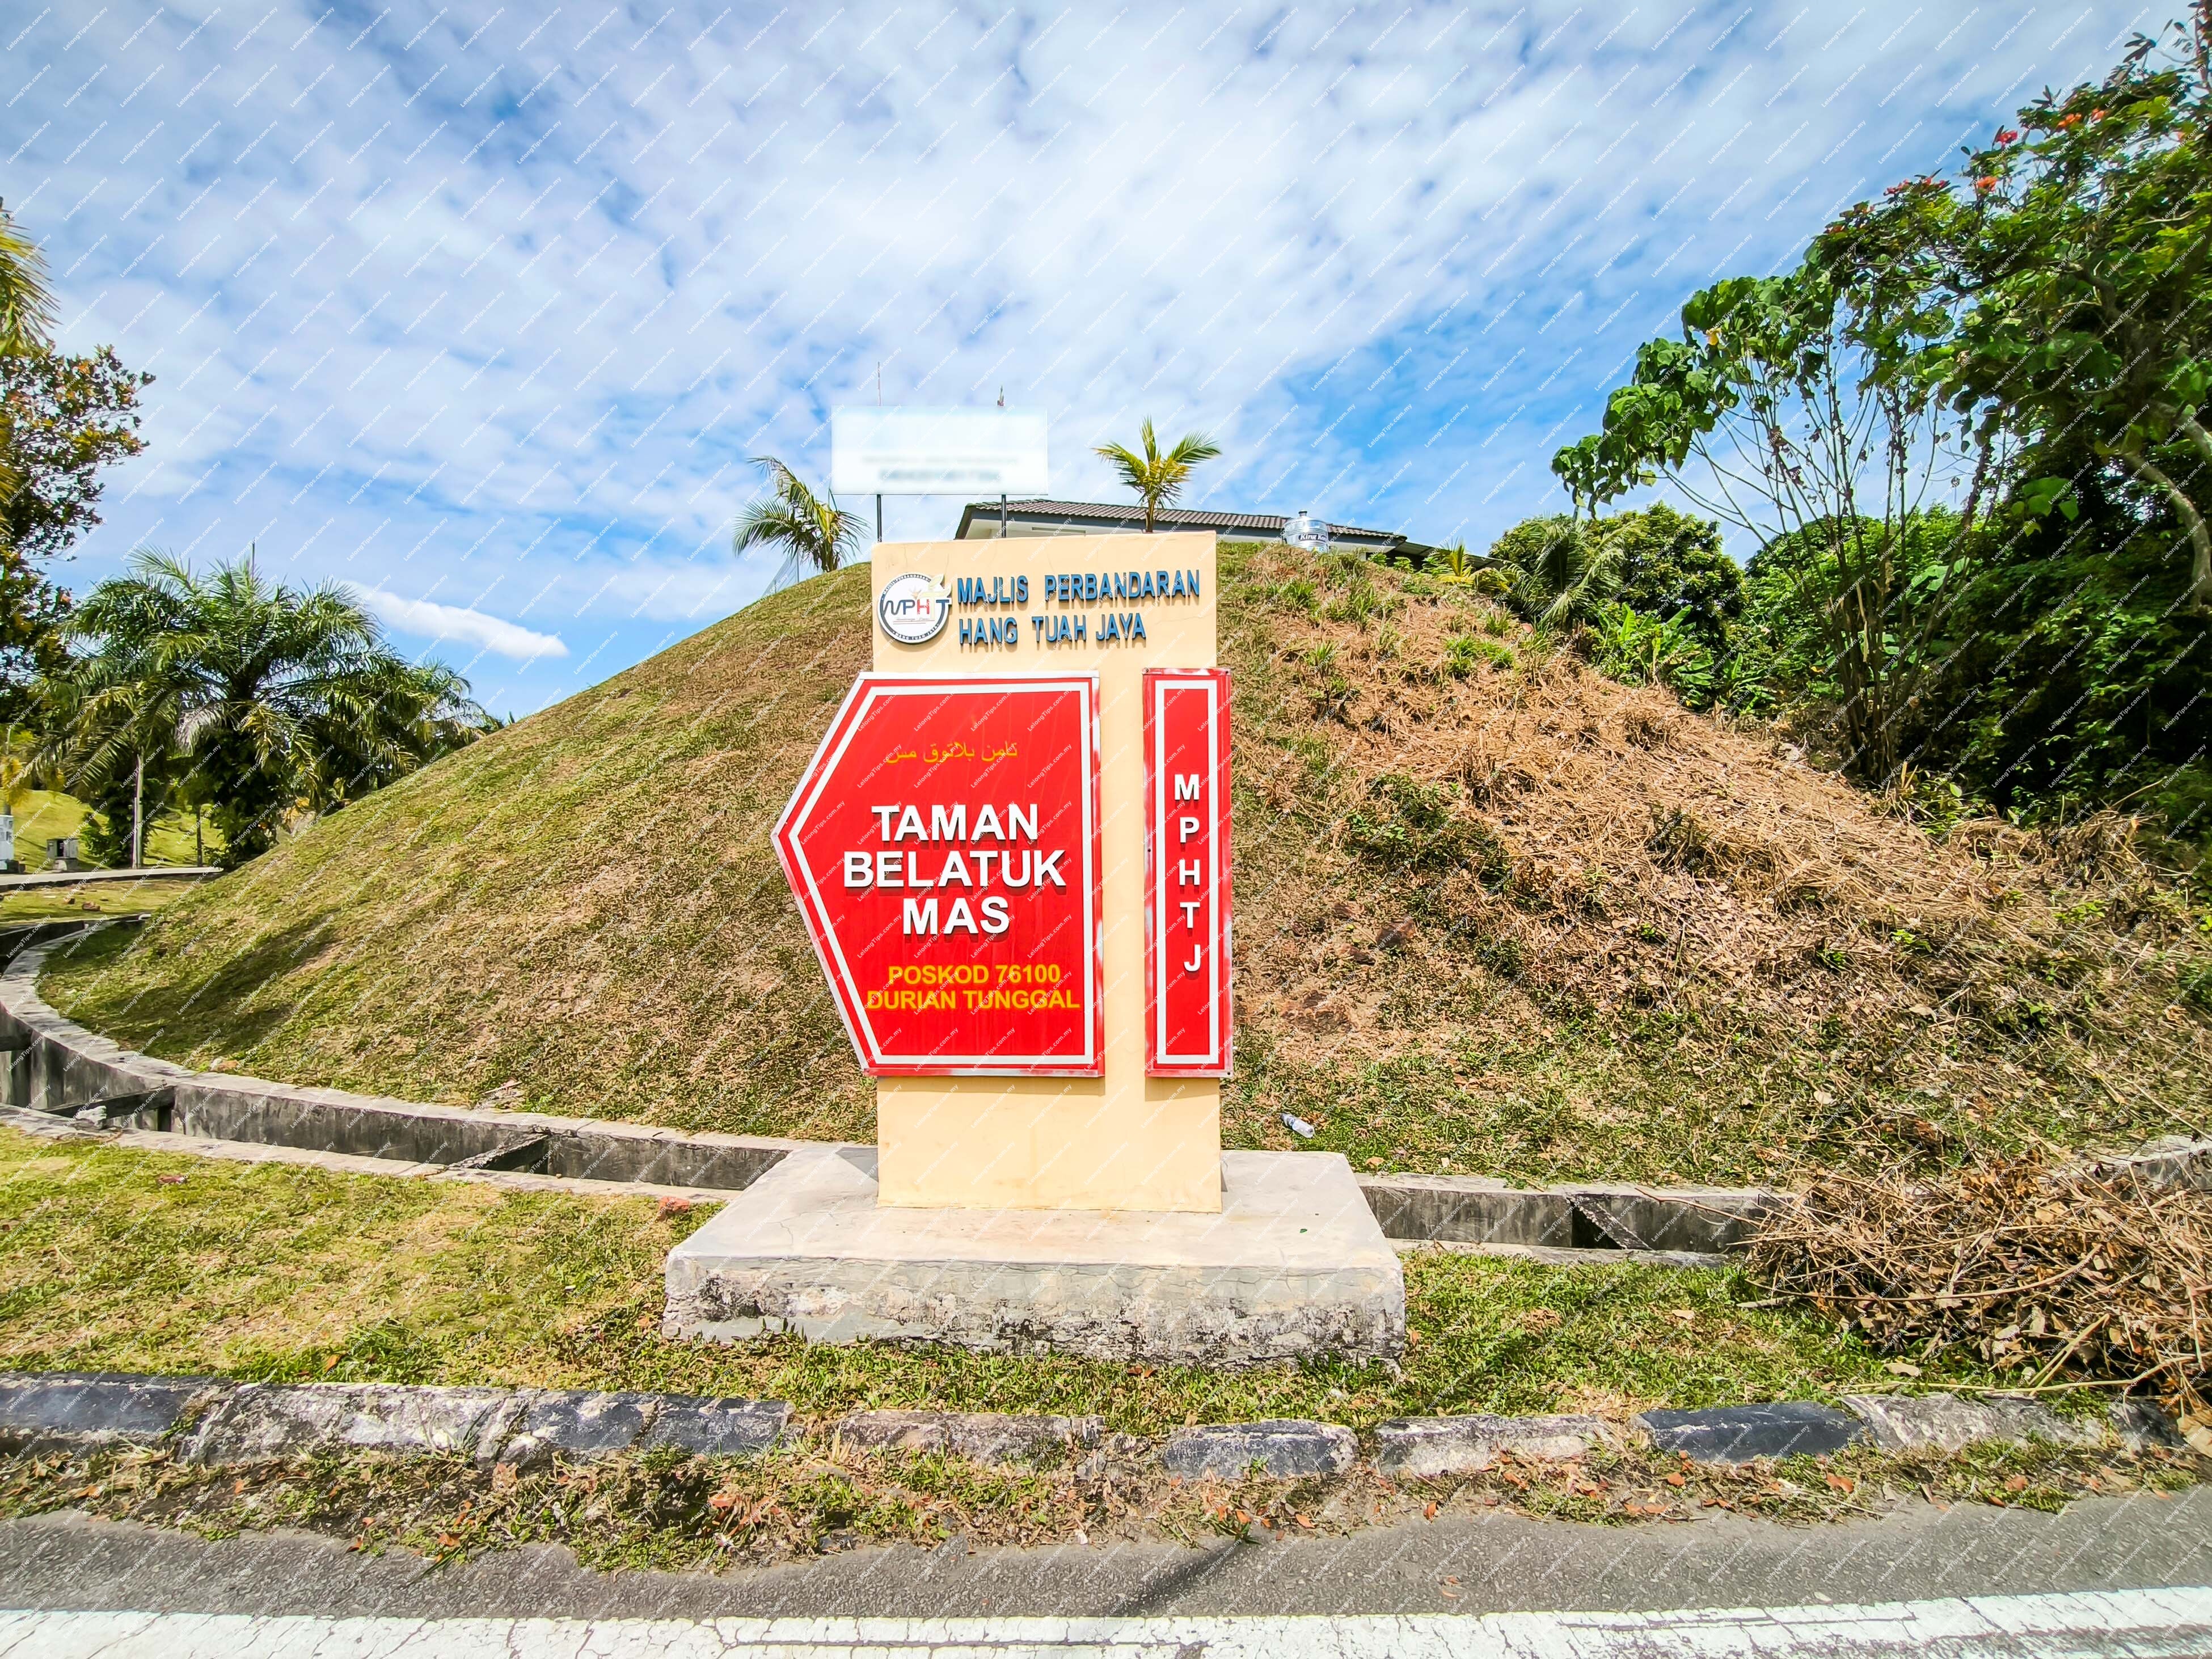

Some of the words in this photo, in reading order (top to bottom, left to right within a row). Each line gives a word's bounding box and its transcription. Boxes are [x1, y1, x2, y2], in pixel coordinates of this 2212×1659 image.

[957, 575, 1029, 603] MAJLIS
[1045, 569, 1200, 601] PERBANDARAN
[959, 617, 1018, 644] HANG
[1032, 615, 1087, 642] TUAH
[1096, 613, 1146, 641] JAYA
[871, 803, 1039, 841] TAMAN
[843, 849, 1066, 887] BELATUK
[1173, 774, 1201, 972] MPHTJ
[903, 896, 1010, 935] MAS
[889, 965, 989, 985] POSKOD
[995, 964, 1061, 983] 76100
[867, 990, 956, 1009] DURIAN
[963, 989, 1079, 1009] TUNGGAL
